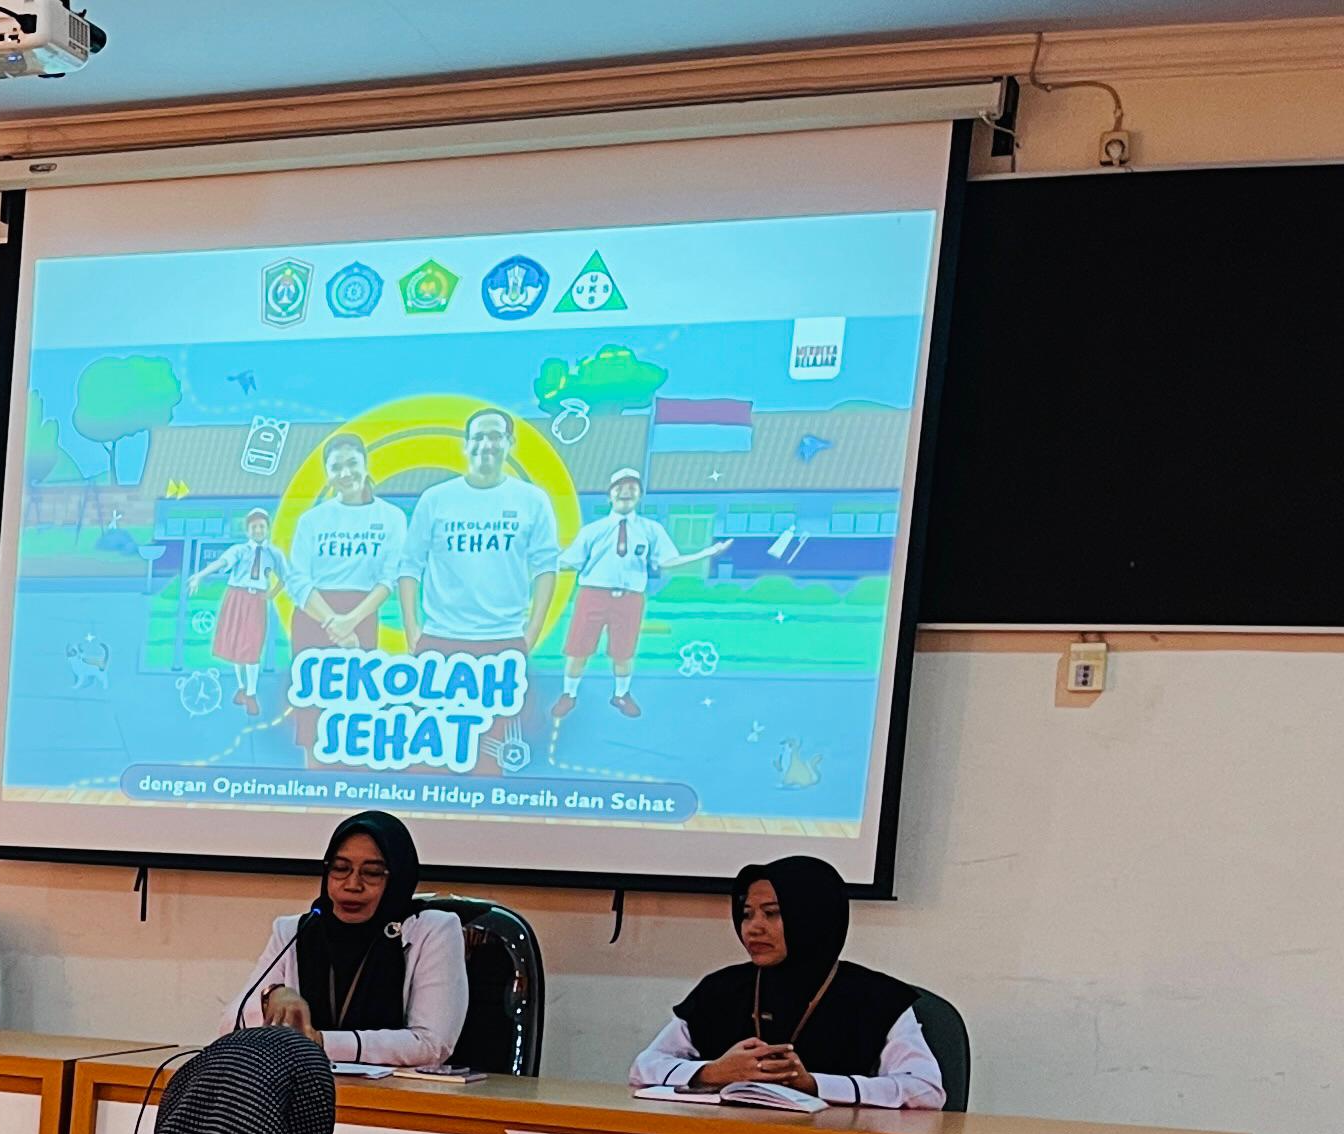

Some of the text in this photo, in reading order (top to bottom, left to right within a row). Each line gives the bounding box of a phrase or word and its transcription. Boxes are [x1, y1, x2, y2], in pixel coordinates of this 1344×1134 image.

[318, 541, 382, 557] SEHAT
[446, 533, 516, 552] SEHAT
[296, 657, 519, 708] SEKOLAH
[322, 713, 484, 764] SEHAT
[139, 776, 675, 812] dengan Optimalkan Perilaku Hidup Bersih dan Sehat
